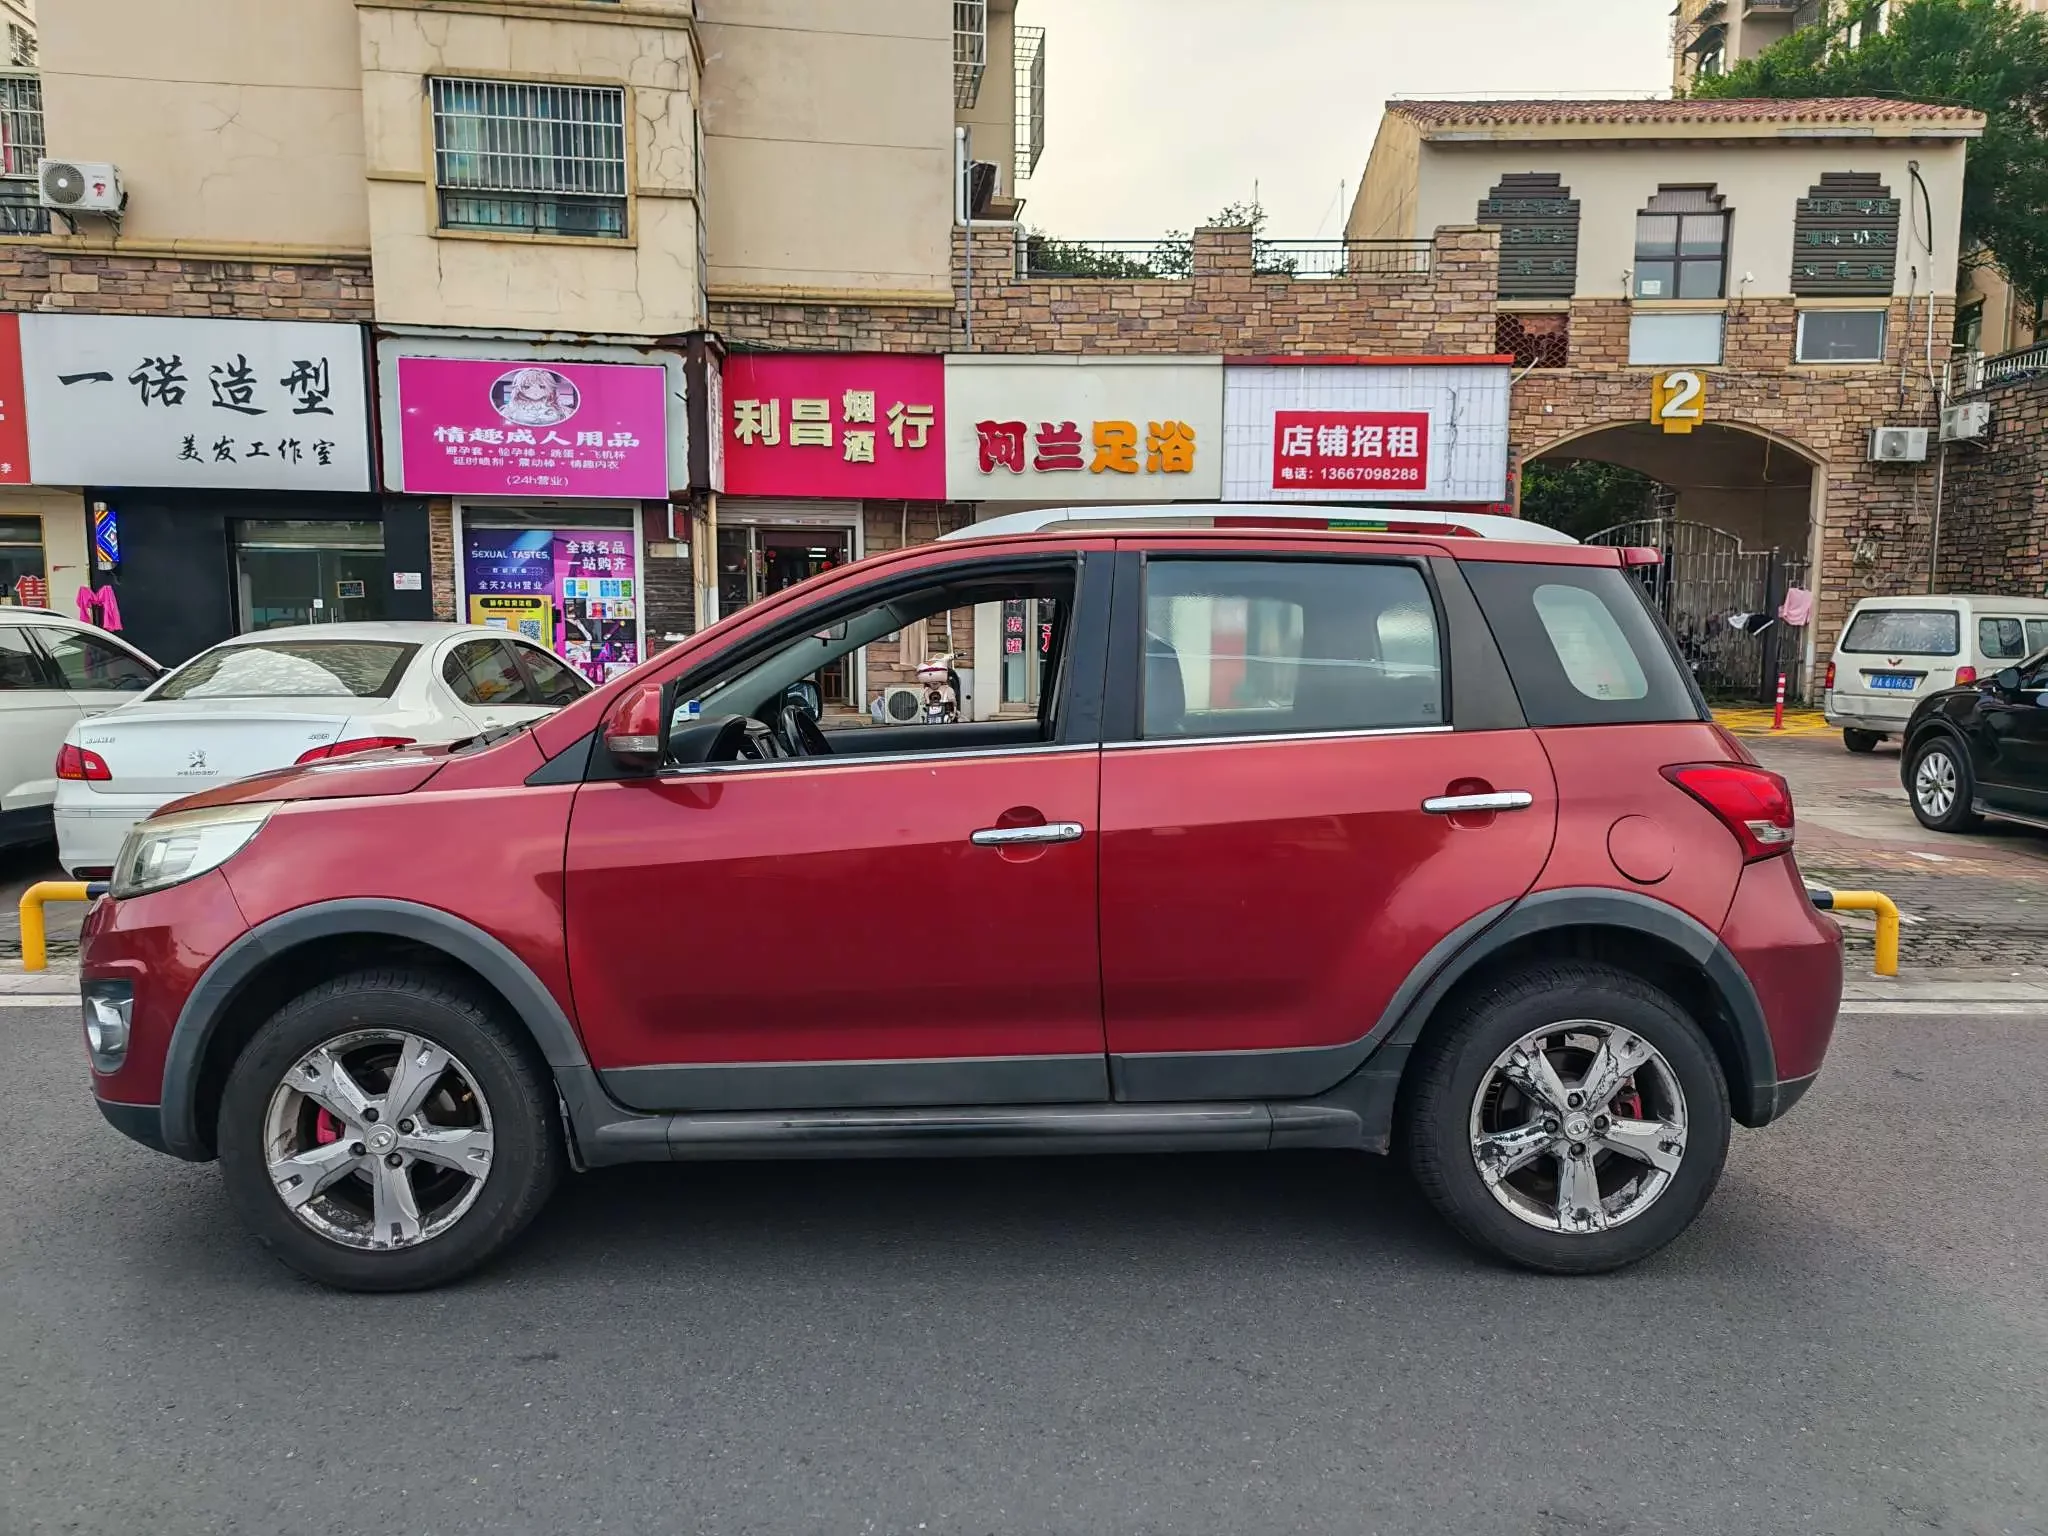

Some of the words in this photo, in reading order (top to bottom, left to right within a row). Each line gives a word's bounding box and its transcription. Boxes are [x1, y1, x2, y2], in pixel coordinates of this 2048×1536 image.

[58, 353, 335, 416] 一诺造型
[1661, 371, 1700, 418] 2
[177, 434, 336, 466] 美发工作室
[433, 426, 640, 448] 情趣成人用品
[975, 420, 1196, 475] 阿兰足浴
[1281, 425, 1419, 458] 店铺招租
[471, 550, 508, 559] SEXUAL
[566, 540, 626, 555] 全球名品
[567, 557, 627, 571] 一站购齐
[478, 580, 543, 590] 全天24H营业
